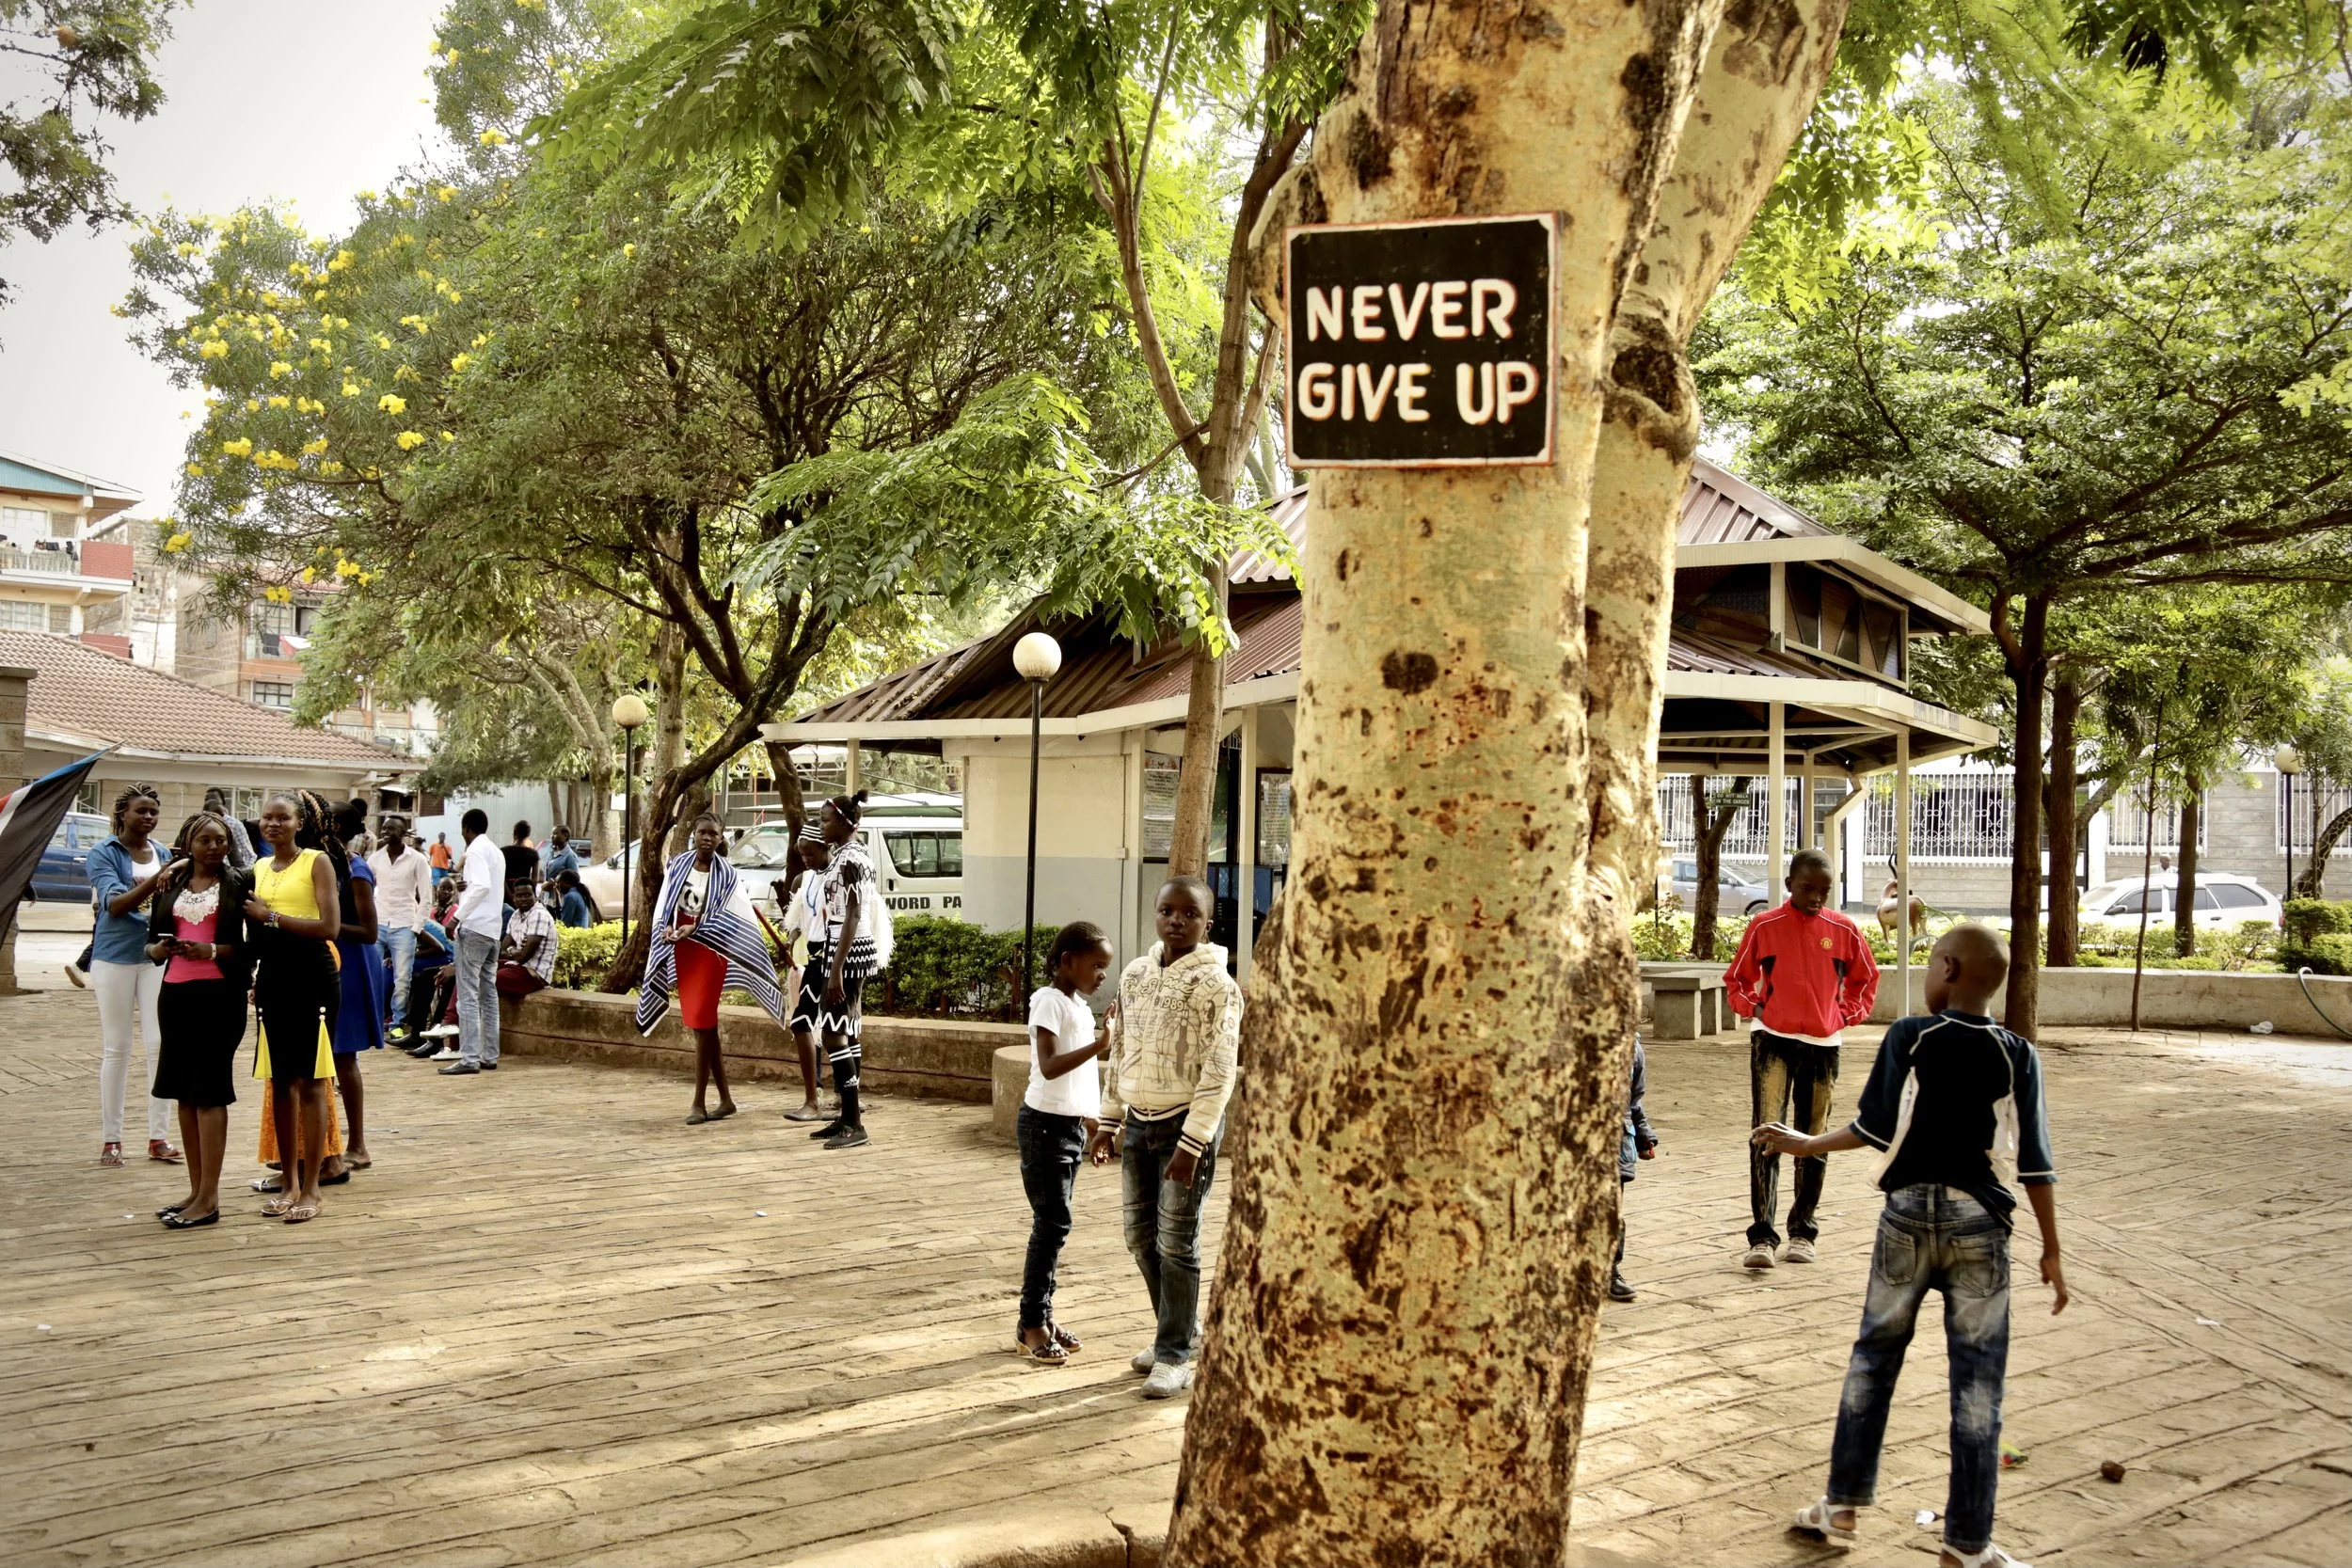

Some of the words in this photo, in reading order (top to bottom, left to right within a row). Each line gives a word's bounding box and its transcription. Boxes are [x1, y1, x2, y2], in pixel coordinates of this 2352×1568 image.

[1306, 278, 1518, 341] NEVER
[1297, 362, 1432, 423] GIVE
[1455, 361, 1540, 425] UP
